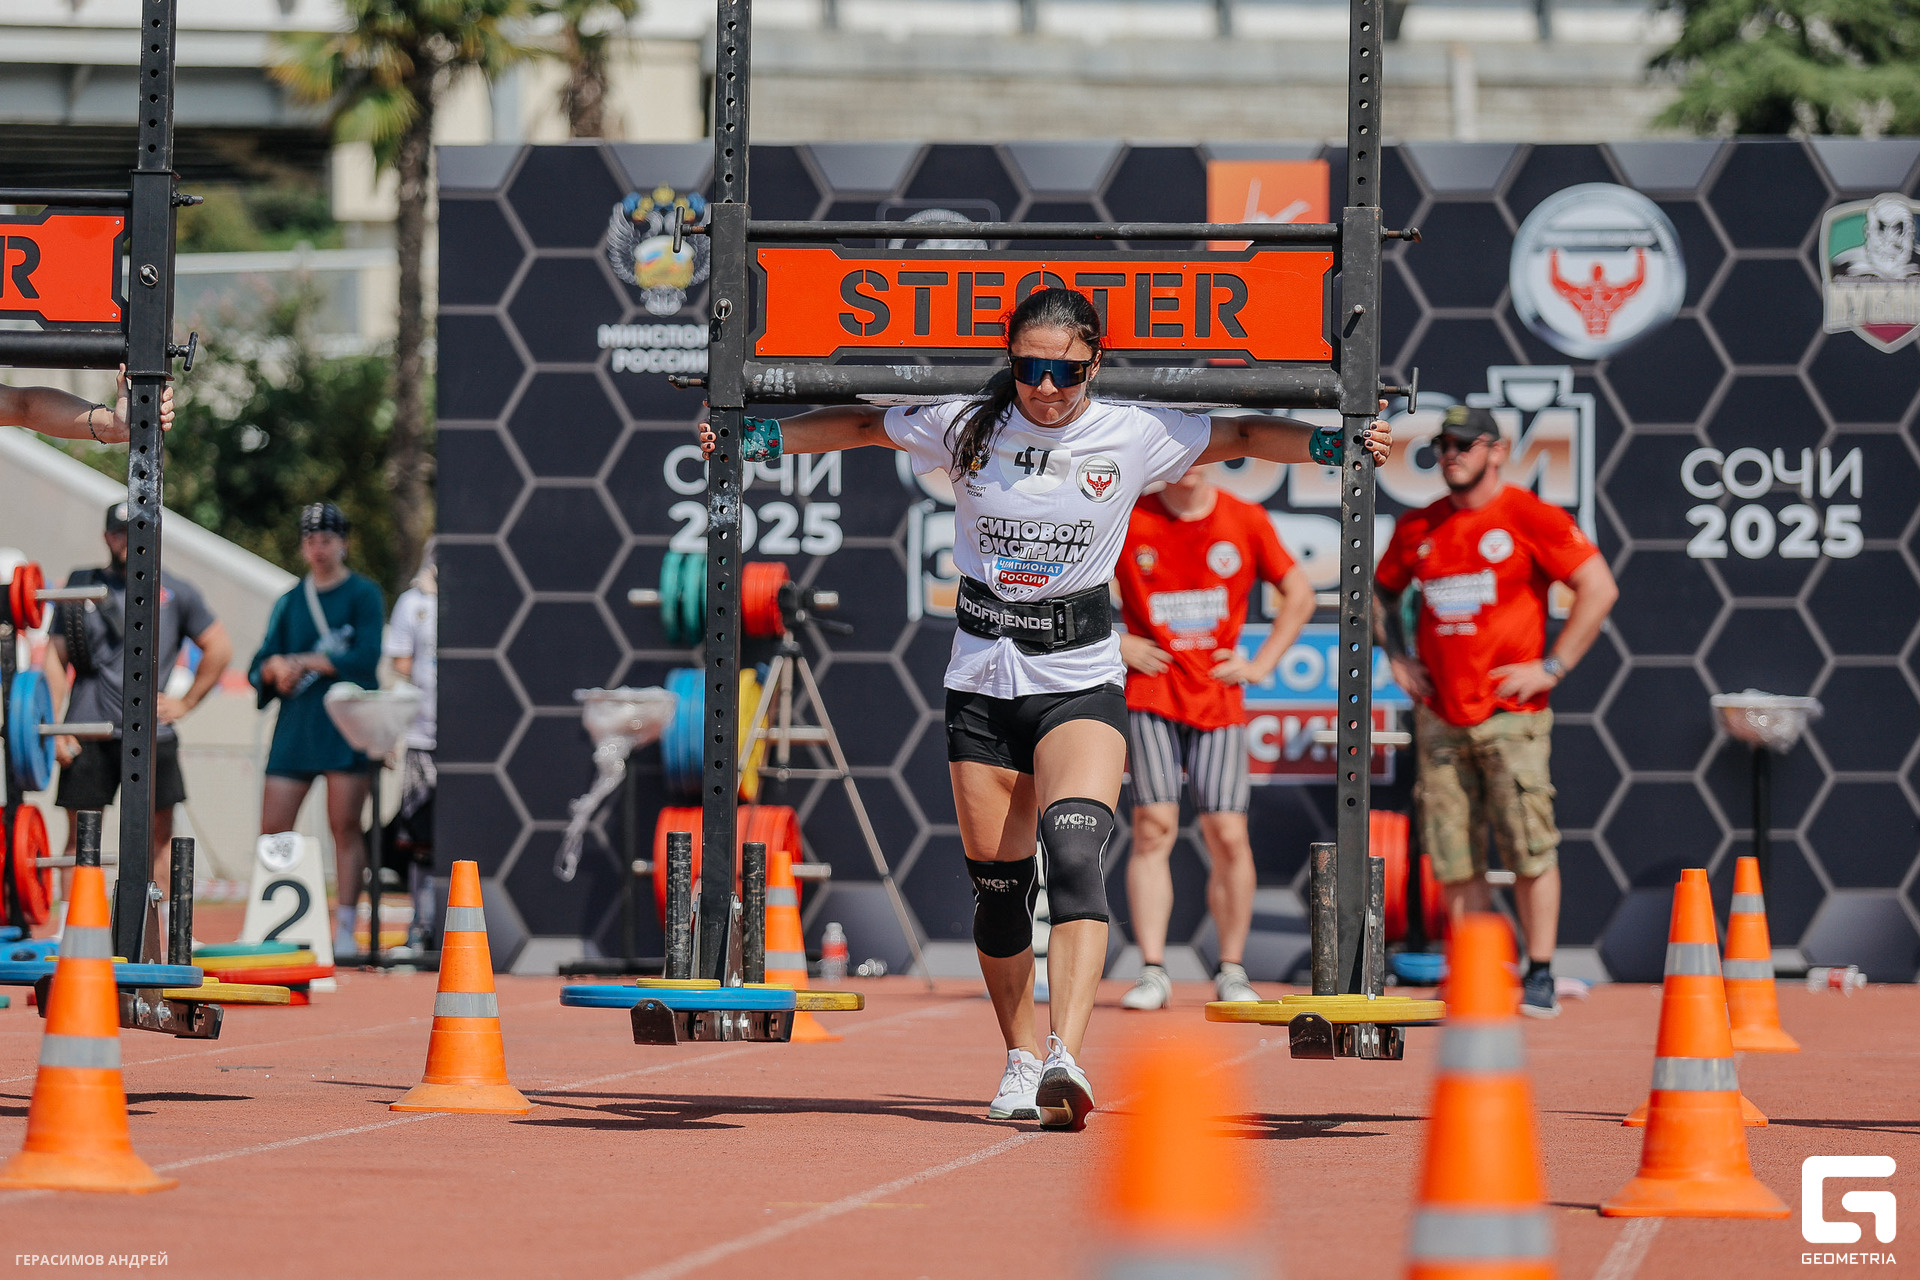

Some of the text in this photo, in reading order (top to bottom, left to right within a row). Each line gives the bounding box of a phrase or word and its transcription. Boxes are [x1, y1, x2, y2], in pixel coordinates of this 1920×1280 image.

[597, 324, 709, 349] МИНСПО
[612, 348, 709, 373] РОССИ
[663, 445, 842, 496] СЧИ
[1680, 447, 1863, 499] СОЧИ
[667, 500, 843, 556] 225
[976, 515, 1094, 545] СИЛОВОЙ
[1685, 503, 1864, 559] 2025
[979, 534, 1090, 564] ЭКСТРИМ
[1000, 571, 1048, 585] РОССИИ
[261, 880, 310, 950] 2
